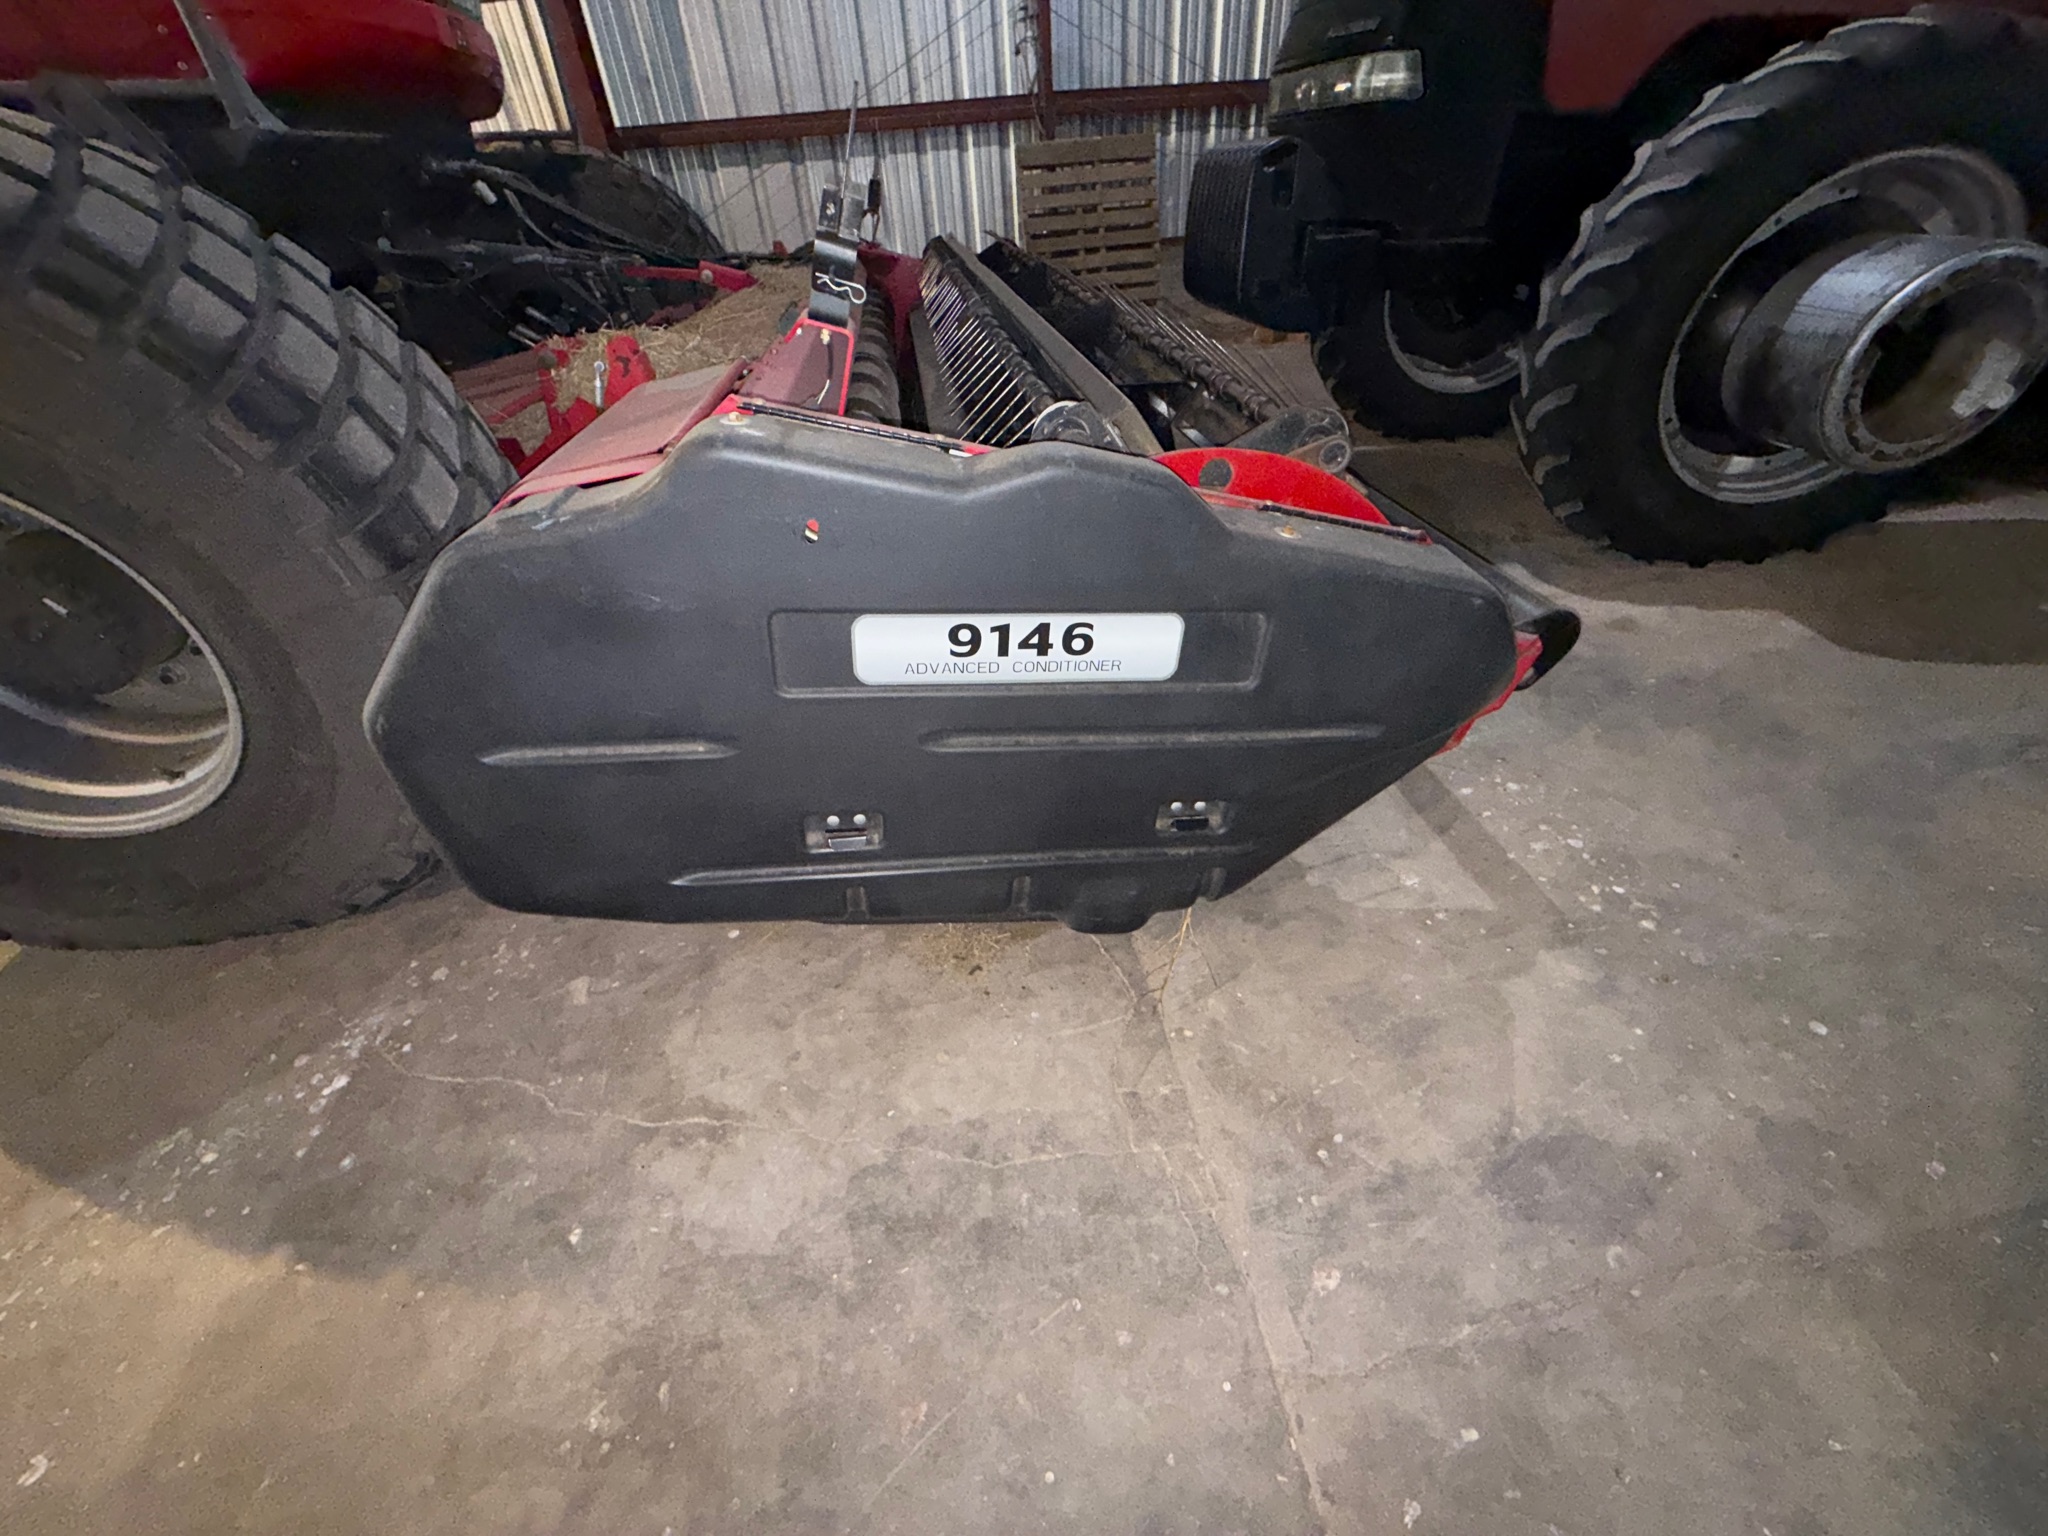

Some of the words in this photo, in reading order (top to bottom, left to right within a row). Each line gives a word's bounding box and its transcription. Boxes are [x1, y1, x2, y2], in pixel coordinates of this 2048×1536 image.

[947, 622, 1095, 657] 9146
[904, 661, 1000, 675] ADVANCED
[1012, 659, 1122, 674] CONDITIONER
